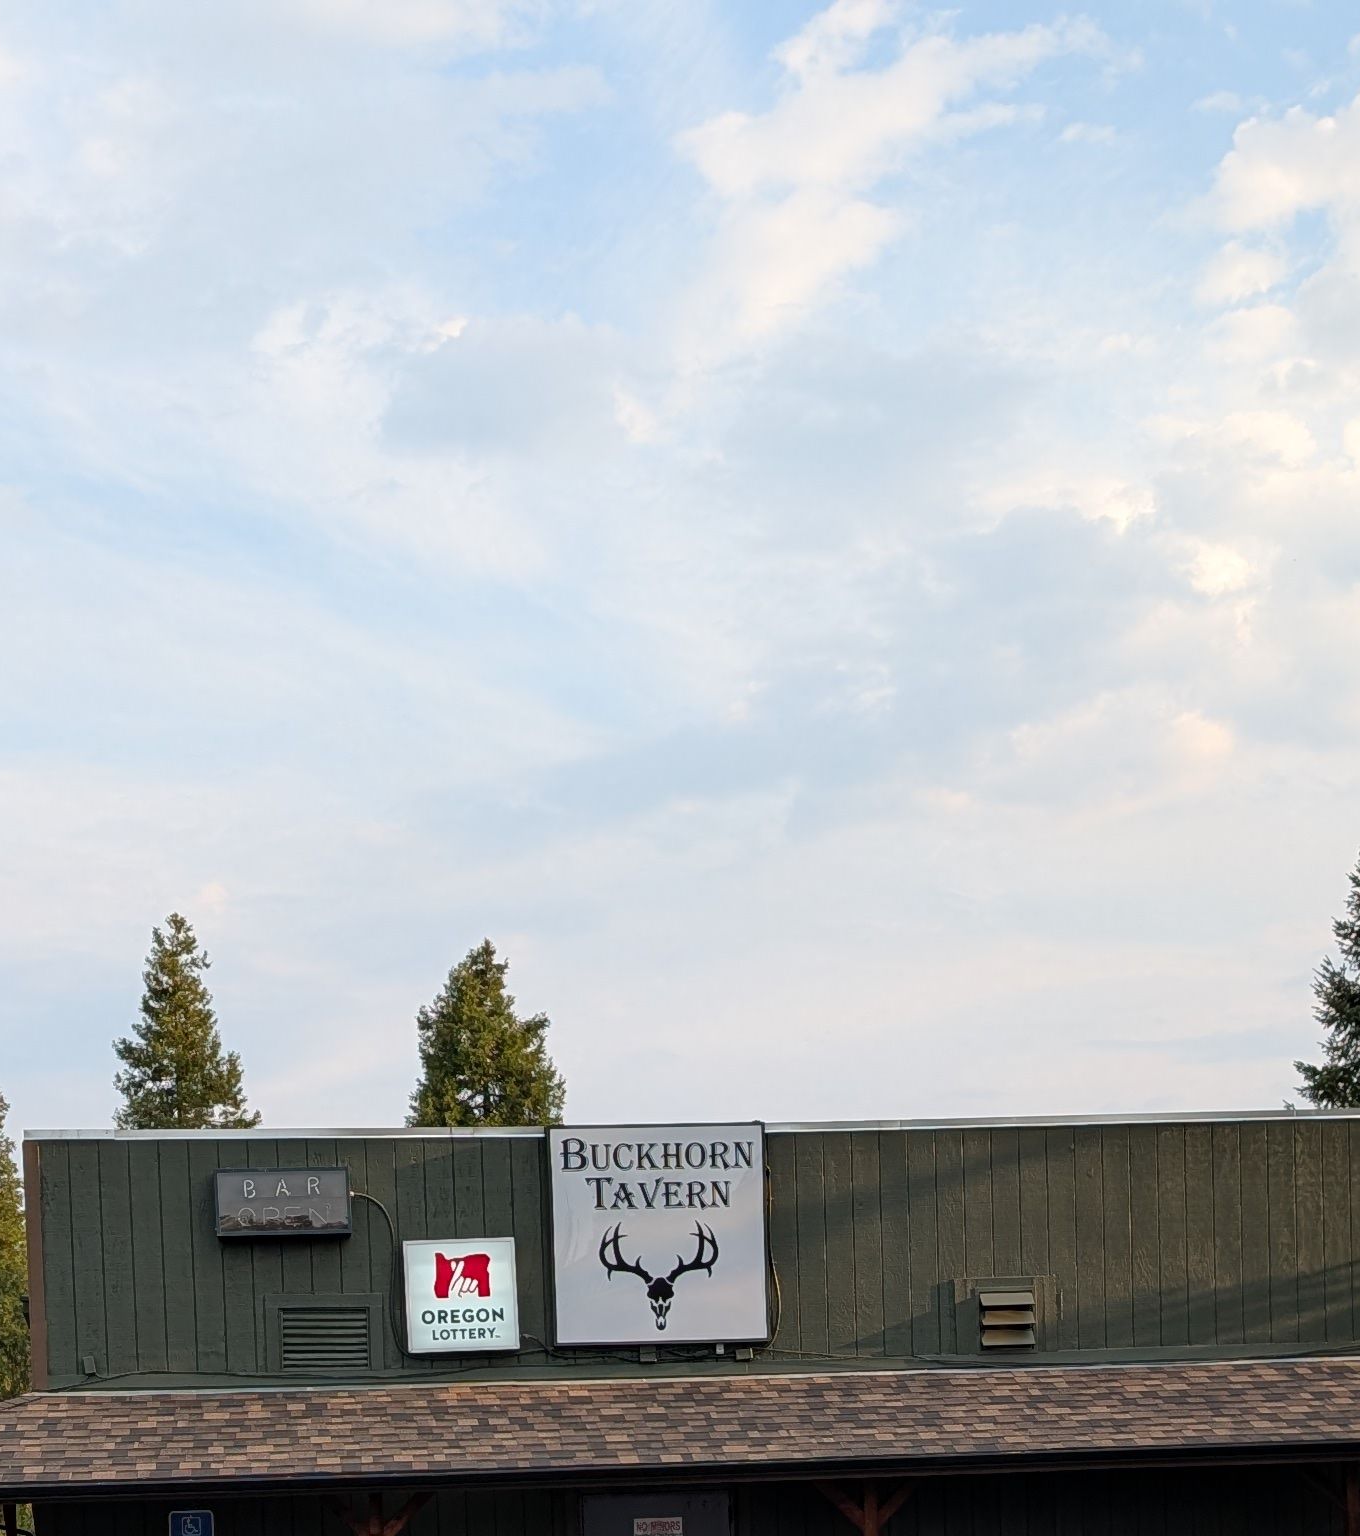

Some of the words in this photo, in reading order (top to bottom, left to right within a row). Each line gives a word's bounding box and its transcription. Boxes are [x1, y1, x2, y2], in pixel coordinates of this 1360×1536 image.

[560, 1138, 754, 1173] BUCKHORN
[243, 1176, 321, 1199] BAR
[585, 1176, 731, 1210] TAVERN
[238, 1203, 329, 1228] OPEN
[421, 1307, 505, 1325] OREGON
[432, 1327, 496, 1341] LOTTERY
